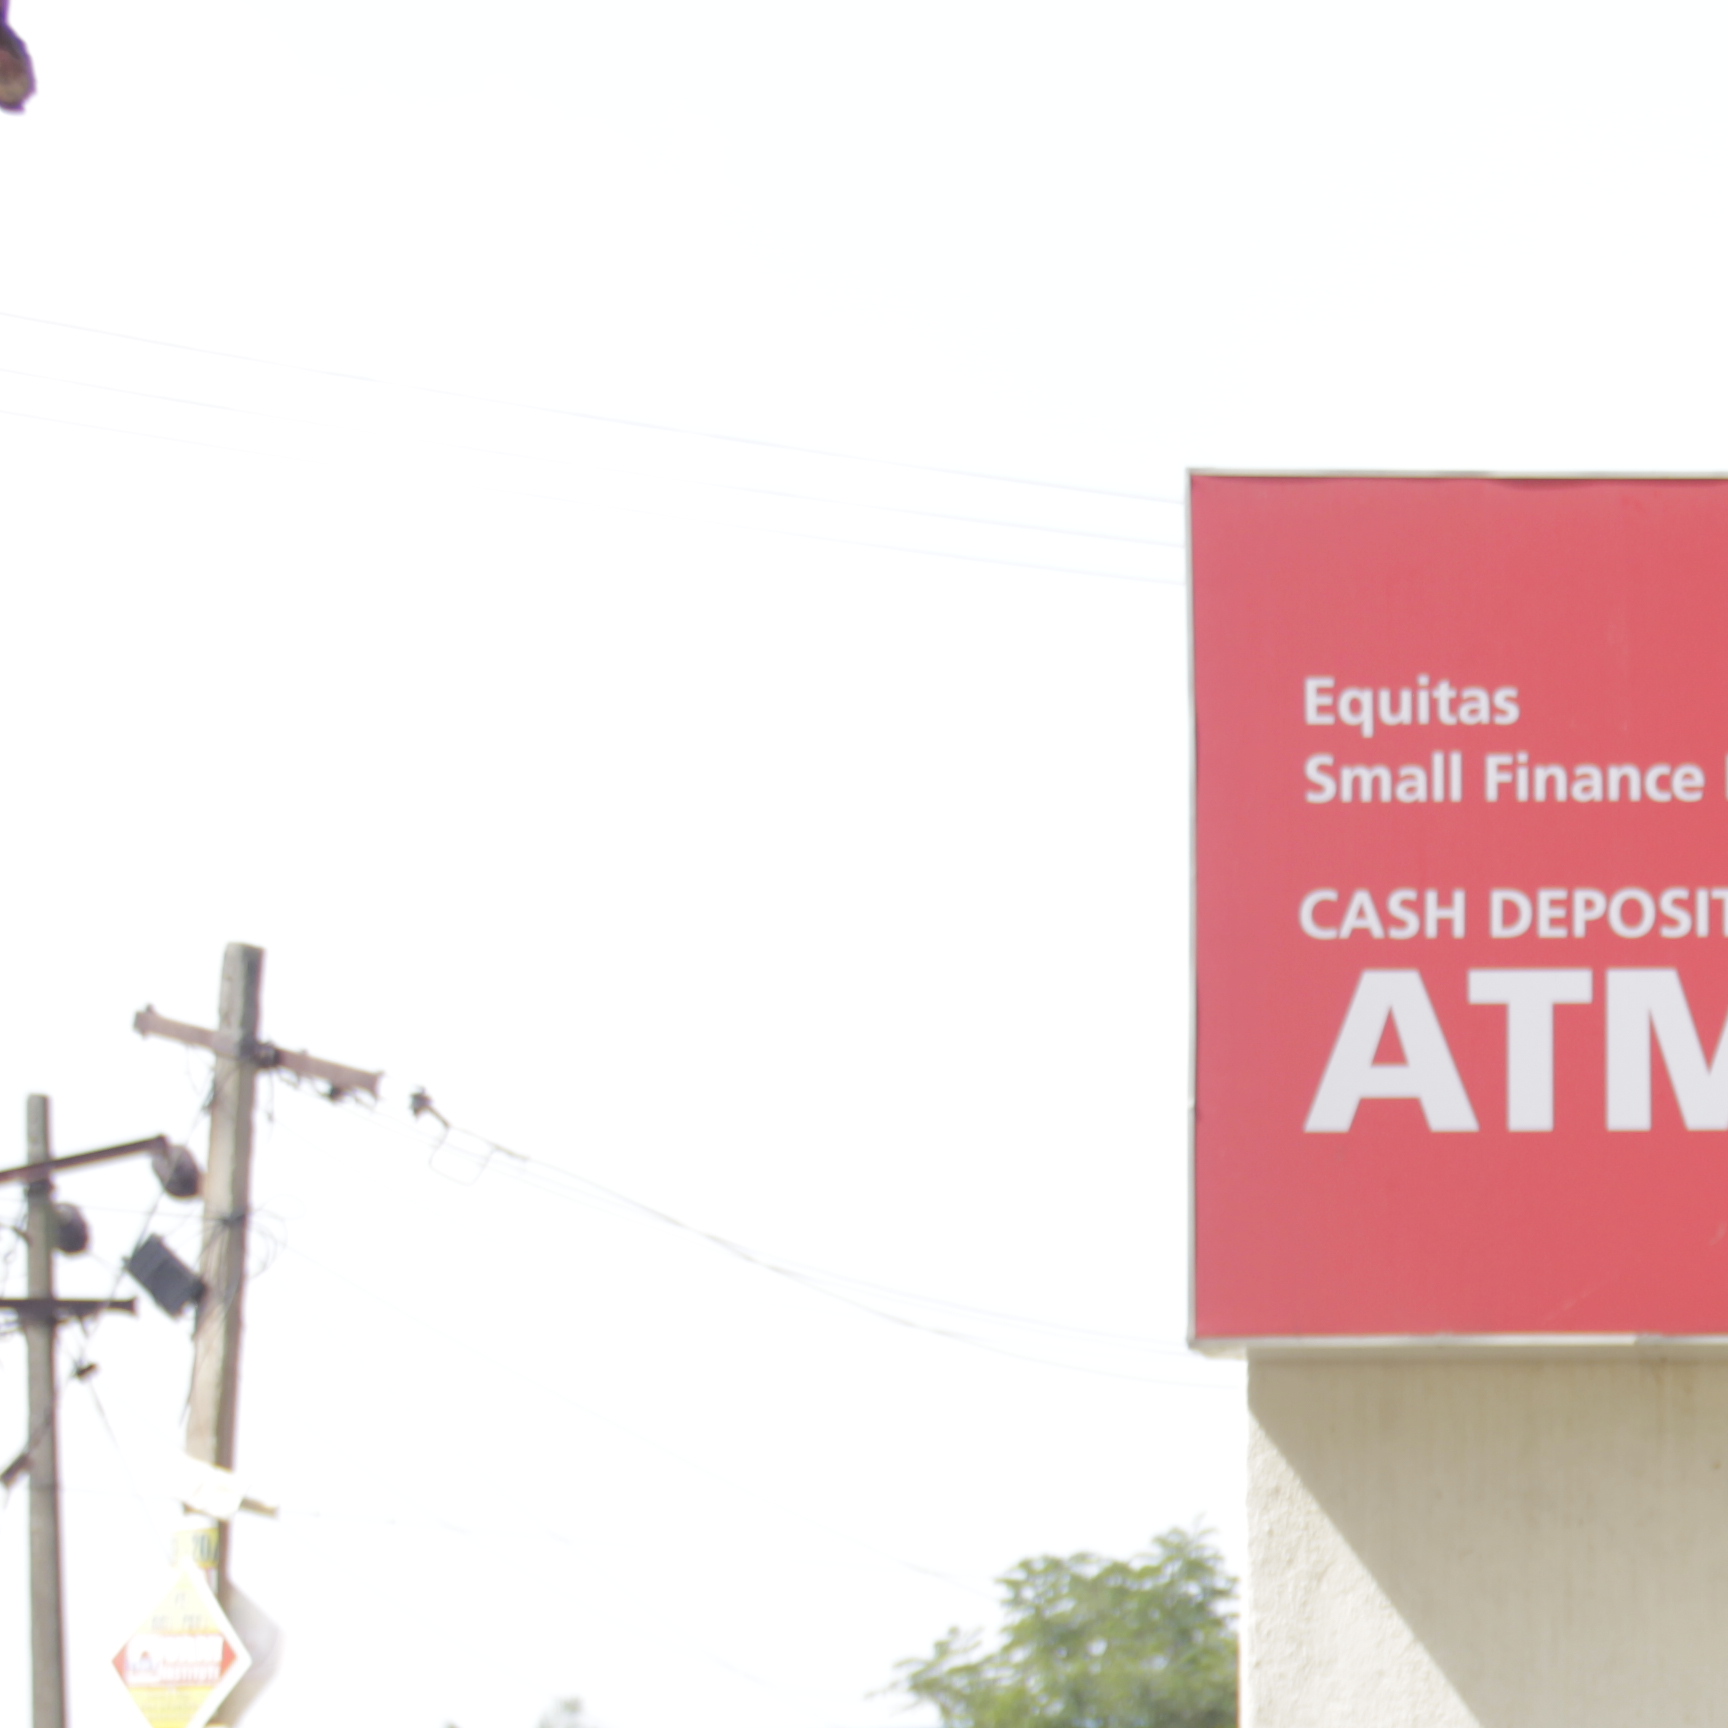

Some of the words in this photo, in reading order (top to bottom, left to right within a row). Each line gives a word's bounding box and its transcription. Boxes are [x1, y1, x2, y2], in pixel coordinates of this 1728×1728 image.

[1303, 673, 1521, 740] Equitas
[1303, 750, 1464, 804] Small
[1484, 750, 1706, 803] Finance
[1298, 887, 1467, 941] CASH
